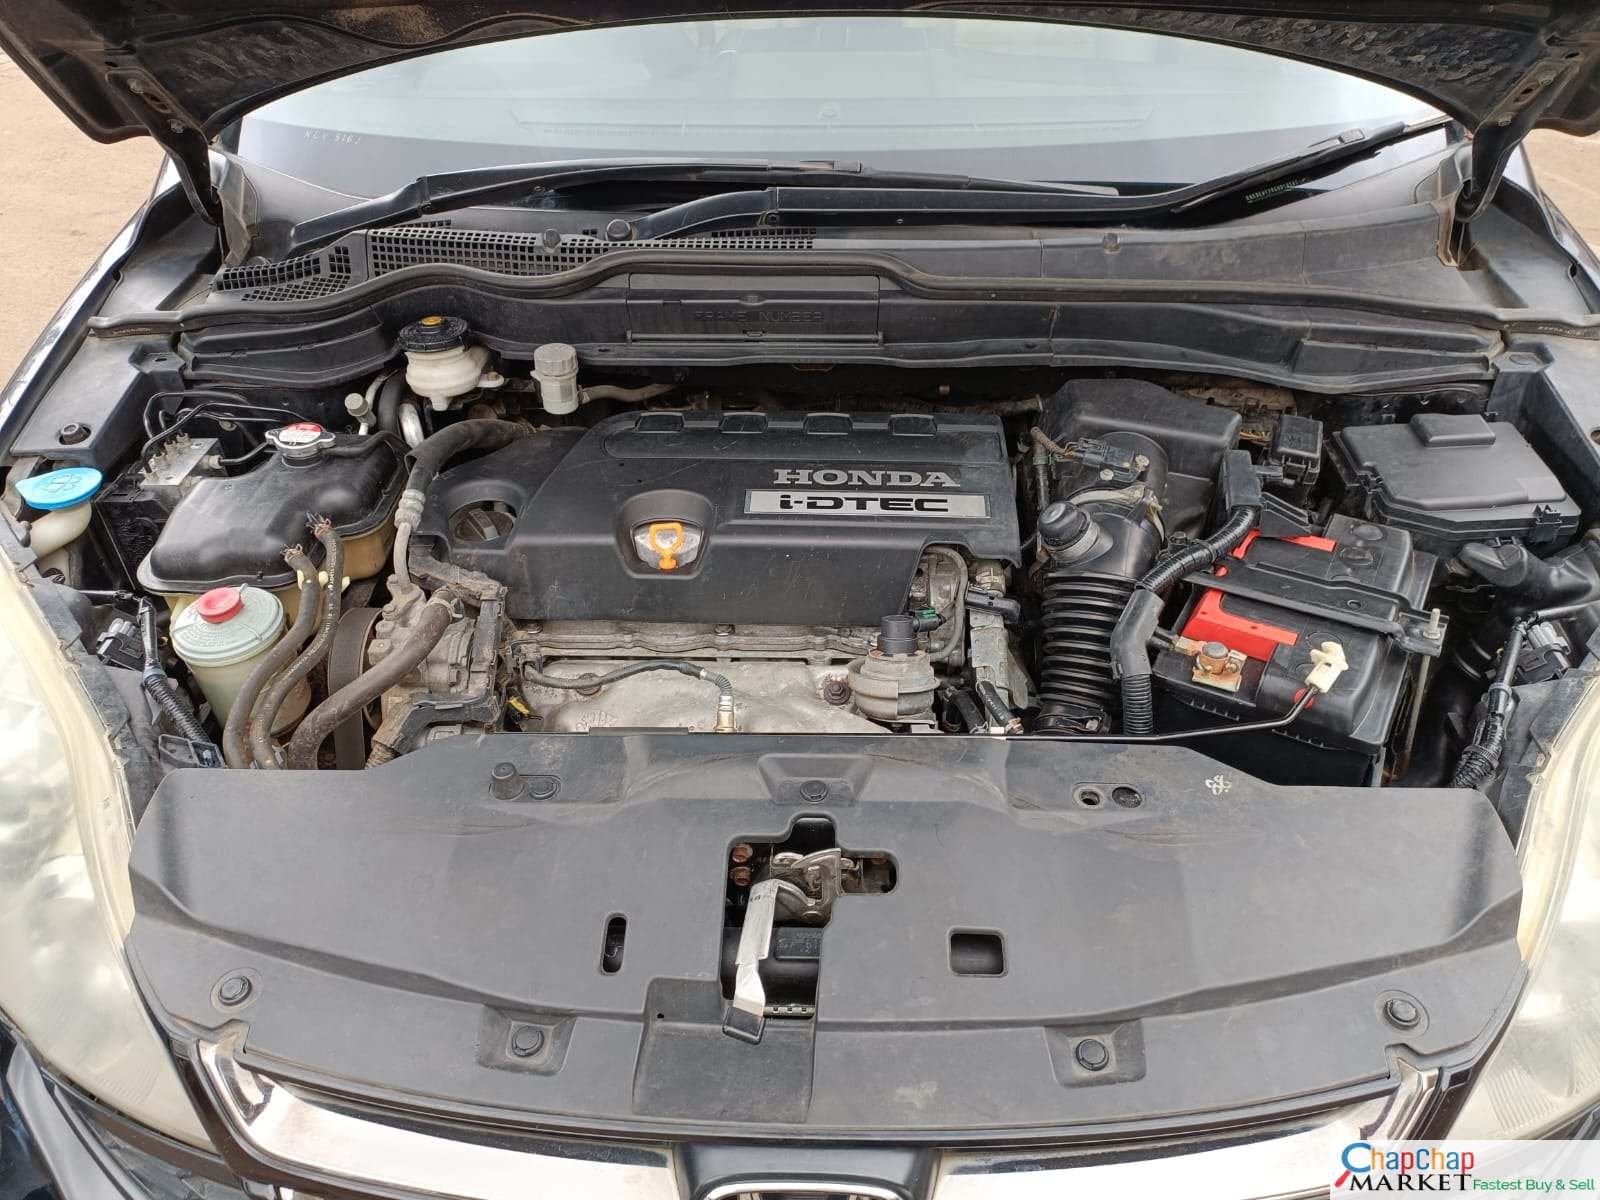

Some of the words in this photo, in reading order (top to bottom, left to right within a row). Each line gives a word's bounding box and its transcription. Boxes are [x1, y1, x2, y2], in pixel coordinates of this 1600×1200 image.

[694, 310, 747, 322] FRAME
[759, 310, 825, 323] NUMBER
[773, 468, 961, 487] HONDA
[780, 494, 949, 513] i-DTEC
